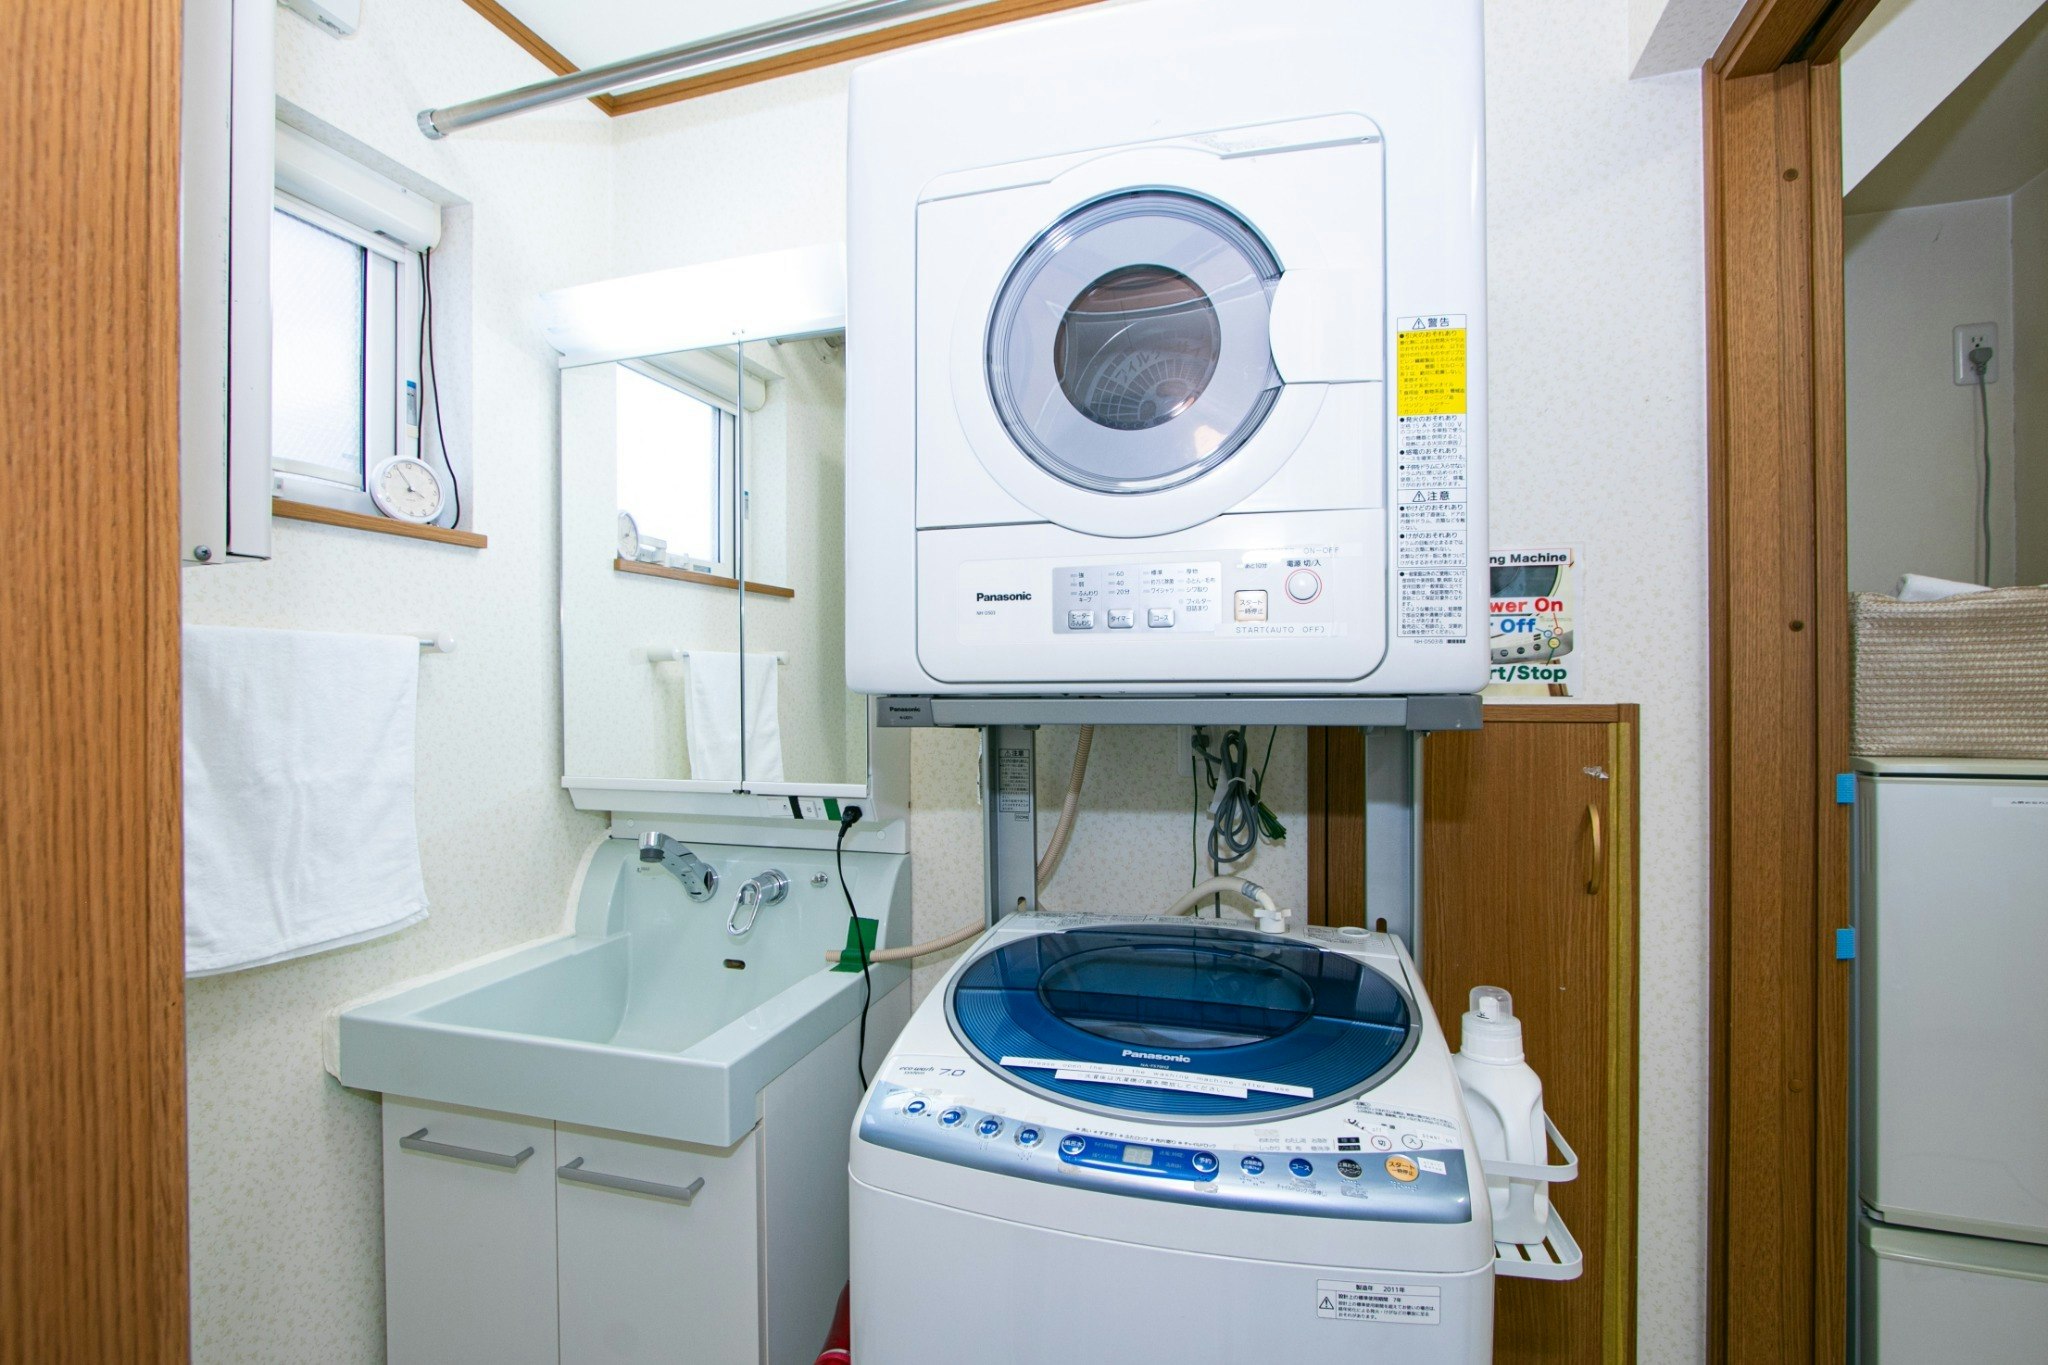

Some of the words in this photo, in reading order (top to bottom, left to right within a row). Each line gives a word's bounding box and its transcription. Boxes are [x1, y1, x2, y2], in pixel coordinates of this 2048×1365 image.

[1428, 317, 1449, 328] 警告
[1406, 415, 1457, 423] 発火のおそれあり
[1405, 448, 1457, 456] 感電のおそれあり
[1427, 491, 1450, 501] 注意
[1510, 552, 1567, 563] Machine
[976, 591, 1032, 602] Panasonic
[1534, 598, 1563, 612] On
[1500, 618, 1536, 633] Off
[1121, 1049, 1191, 1063] Panasonic
[938, 1068, 965, 1077] 7.0
[1377, 1138, 1386, 1147] 切
[1292, 1163, 1311, 1173] コース
[1388, 1161, 1415, 1171] スタート
